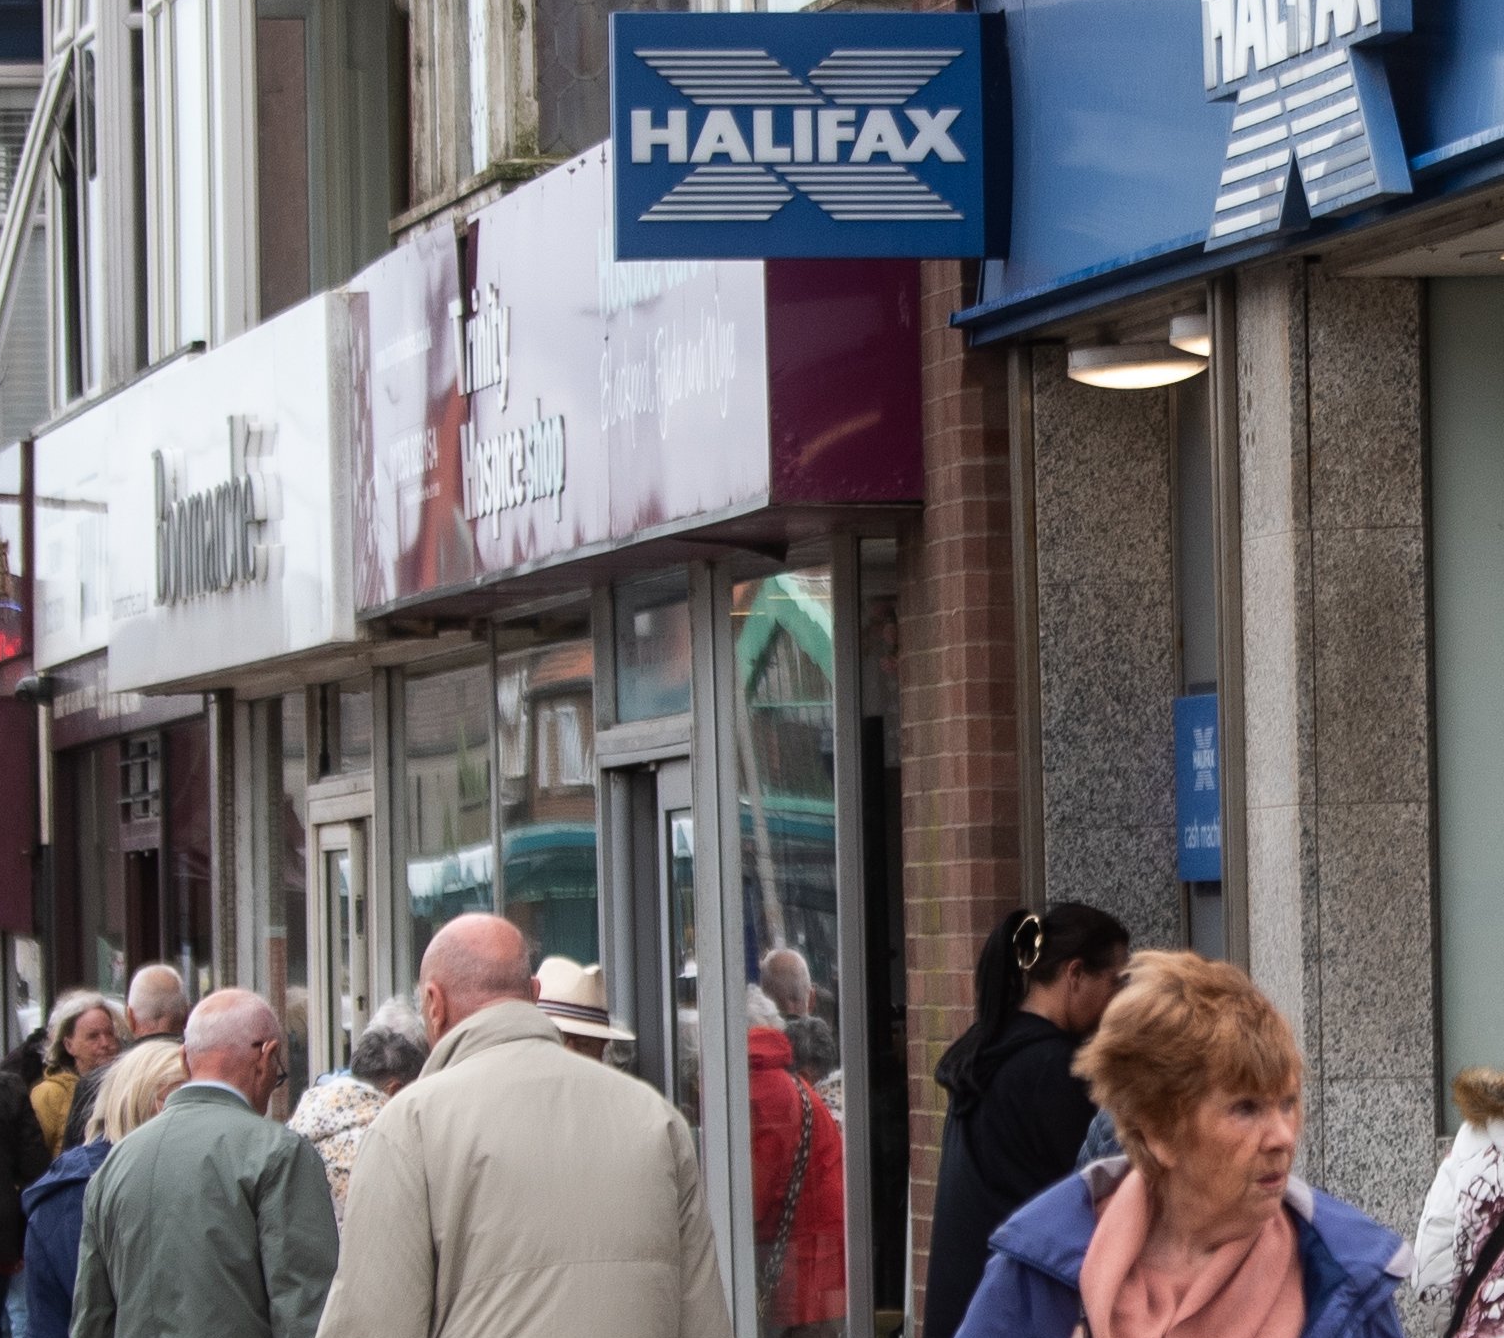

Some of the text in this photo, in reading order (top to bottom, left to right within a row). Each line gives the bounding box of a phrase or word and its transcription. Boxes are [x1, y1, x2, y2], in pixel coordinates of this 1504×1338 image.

[631, 108, 966, 164] HALIFAX
[448, 282, 511, 413] Trinity
[459, 420, 525, 541] Hospice
[527, 397, 566, 523] shop
